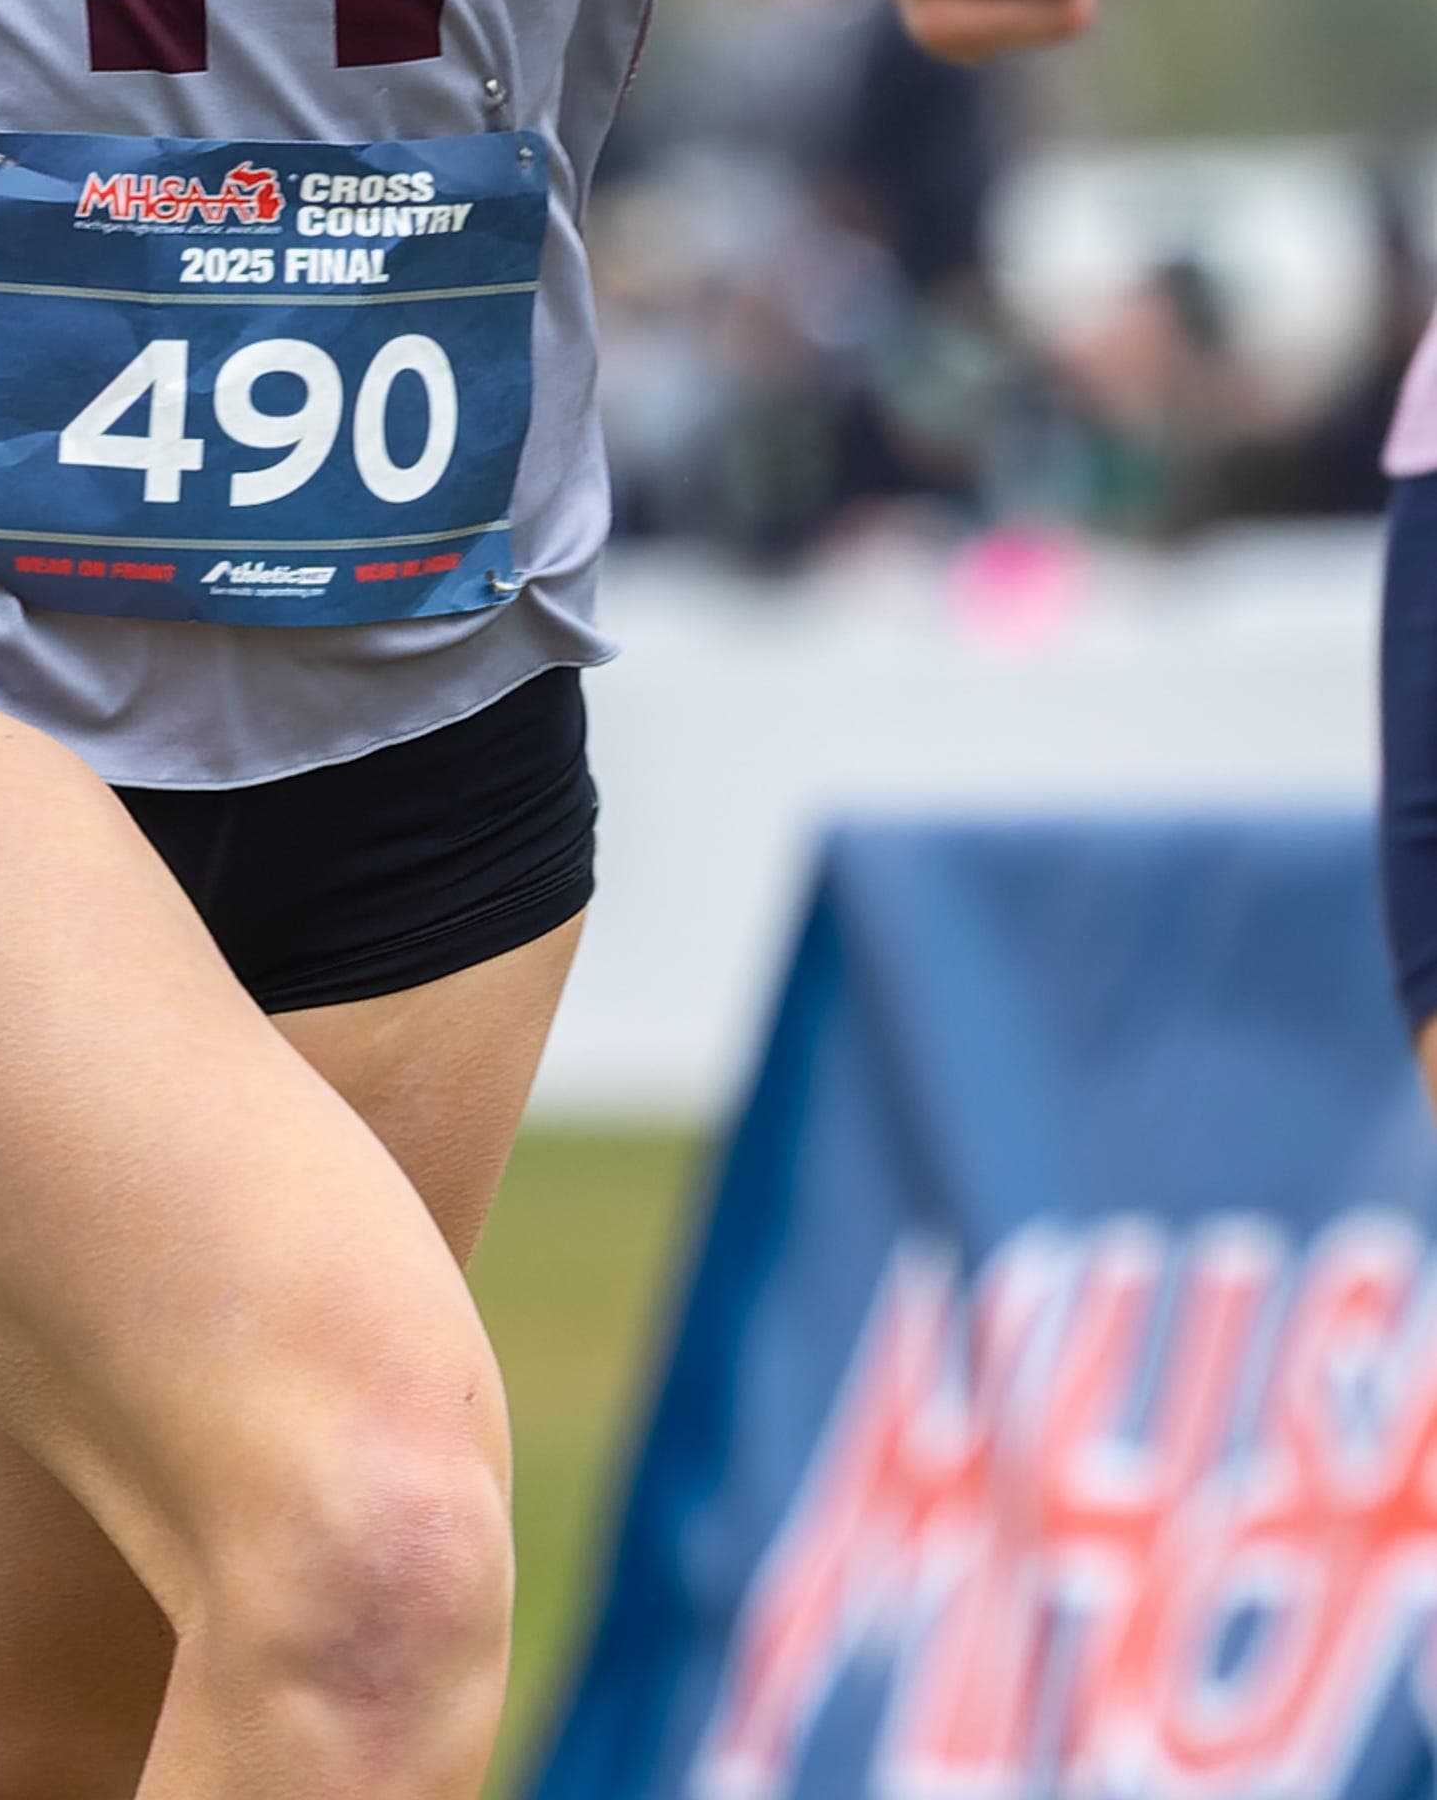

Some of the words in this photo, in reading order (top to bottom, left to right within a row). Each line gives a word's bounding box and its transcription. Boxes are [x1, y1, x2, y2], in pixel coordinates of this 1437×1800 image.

[74, 171, 256, 224] MHSAA
[300, 171, 436, 203] CROSS
[296, 202, 474, 237] COUNTRY
[179, 247, 275, 283] 2025
[284, 248, 390, 284] FINAL
[59, 334, 458, 507] 490
